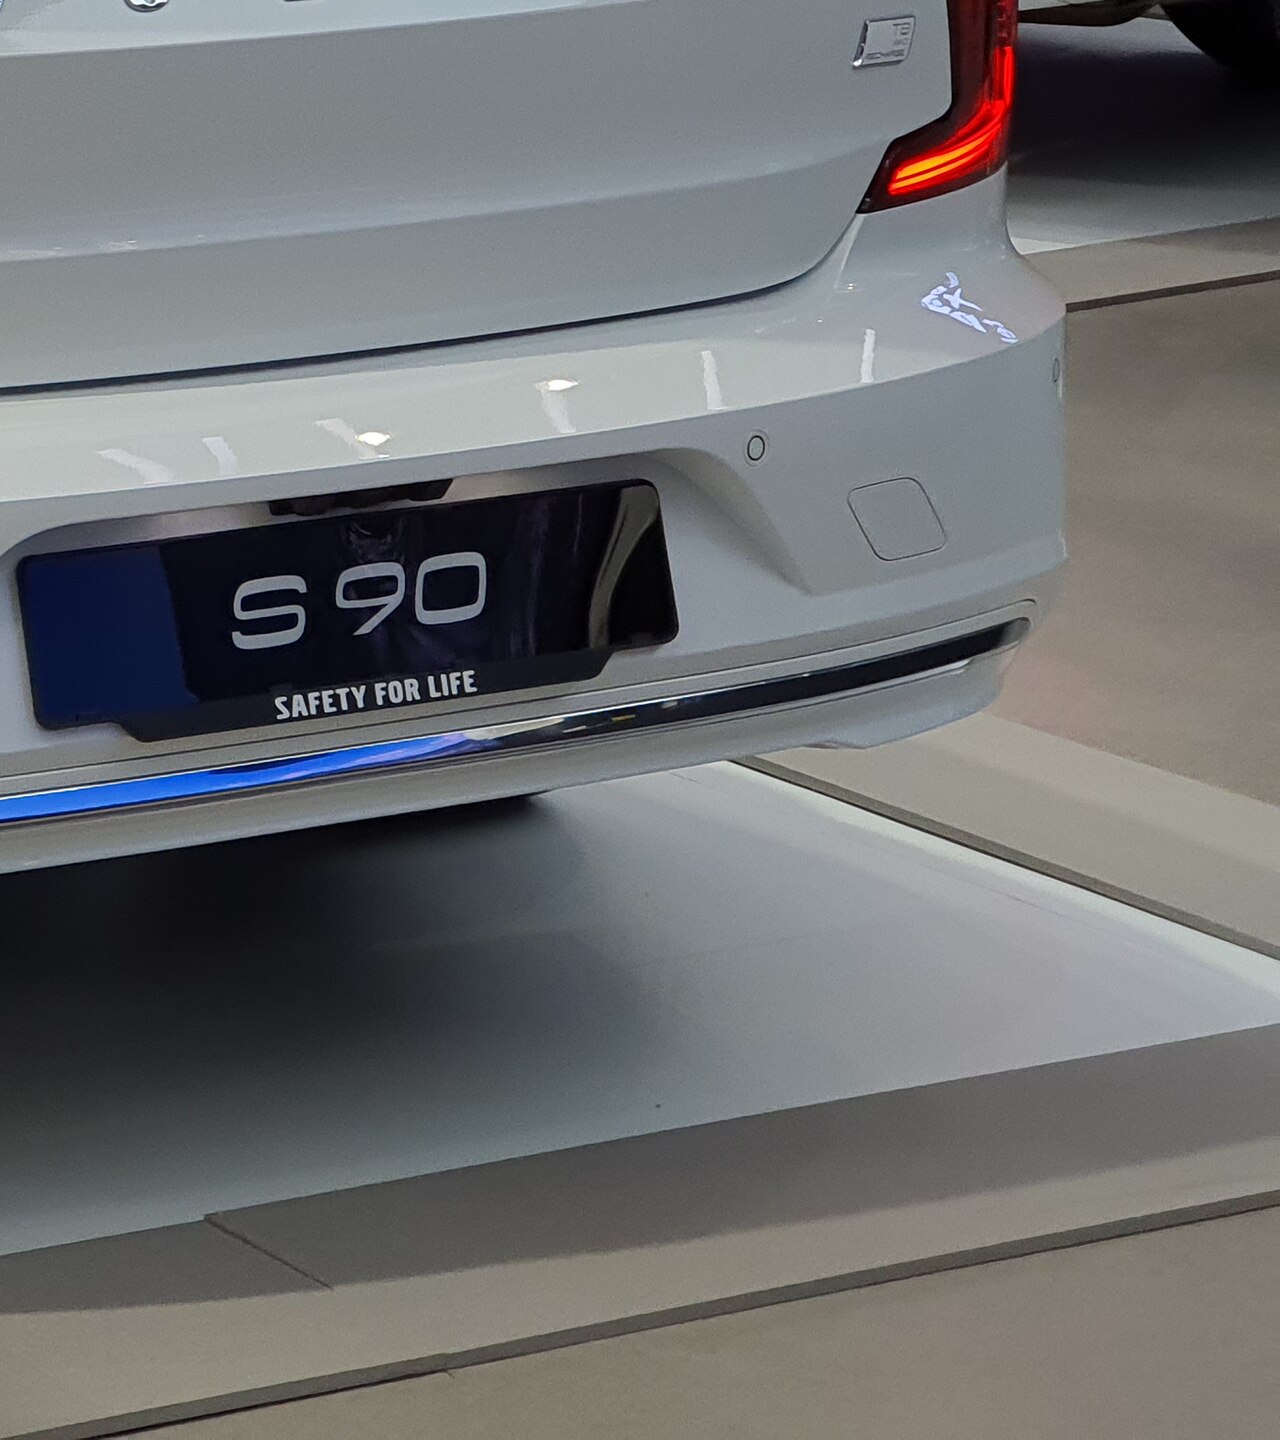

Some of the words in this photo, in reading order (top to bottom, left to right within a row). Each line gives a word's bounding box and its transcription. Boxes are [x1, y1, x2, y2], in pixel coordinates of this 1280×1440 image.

[274, 685, 366, 721] SAFETY
[374, 678, 421, 707] FOR
[427, 669, 479, 699] LIFE
